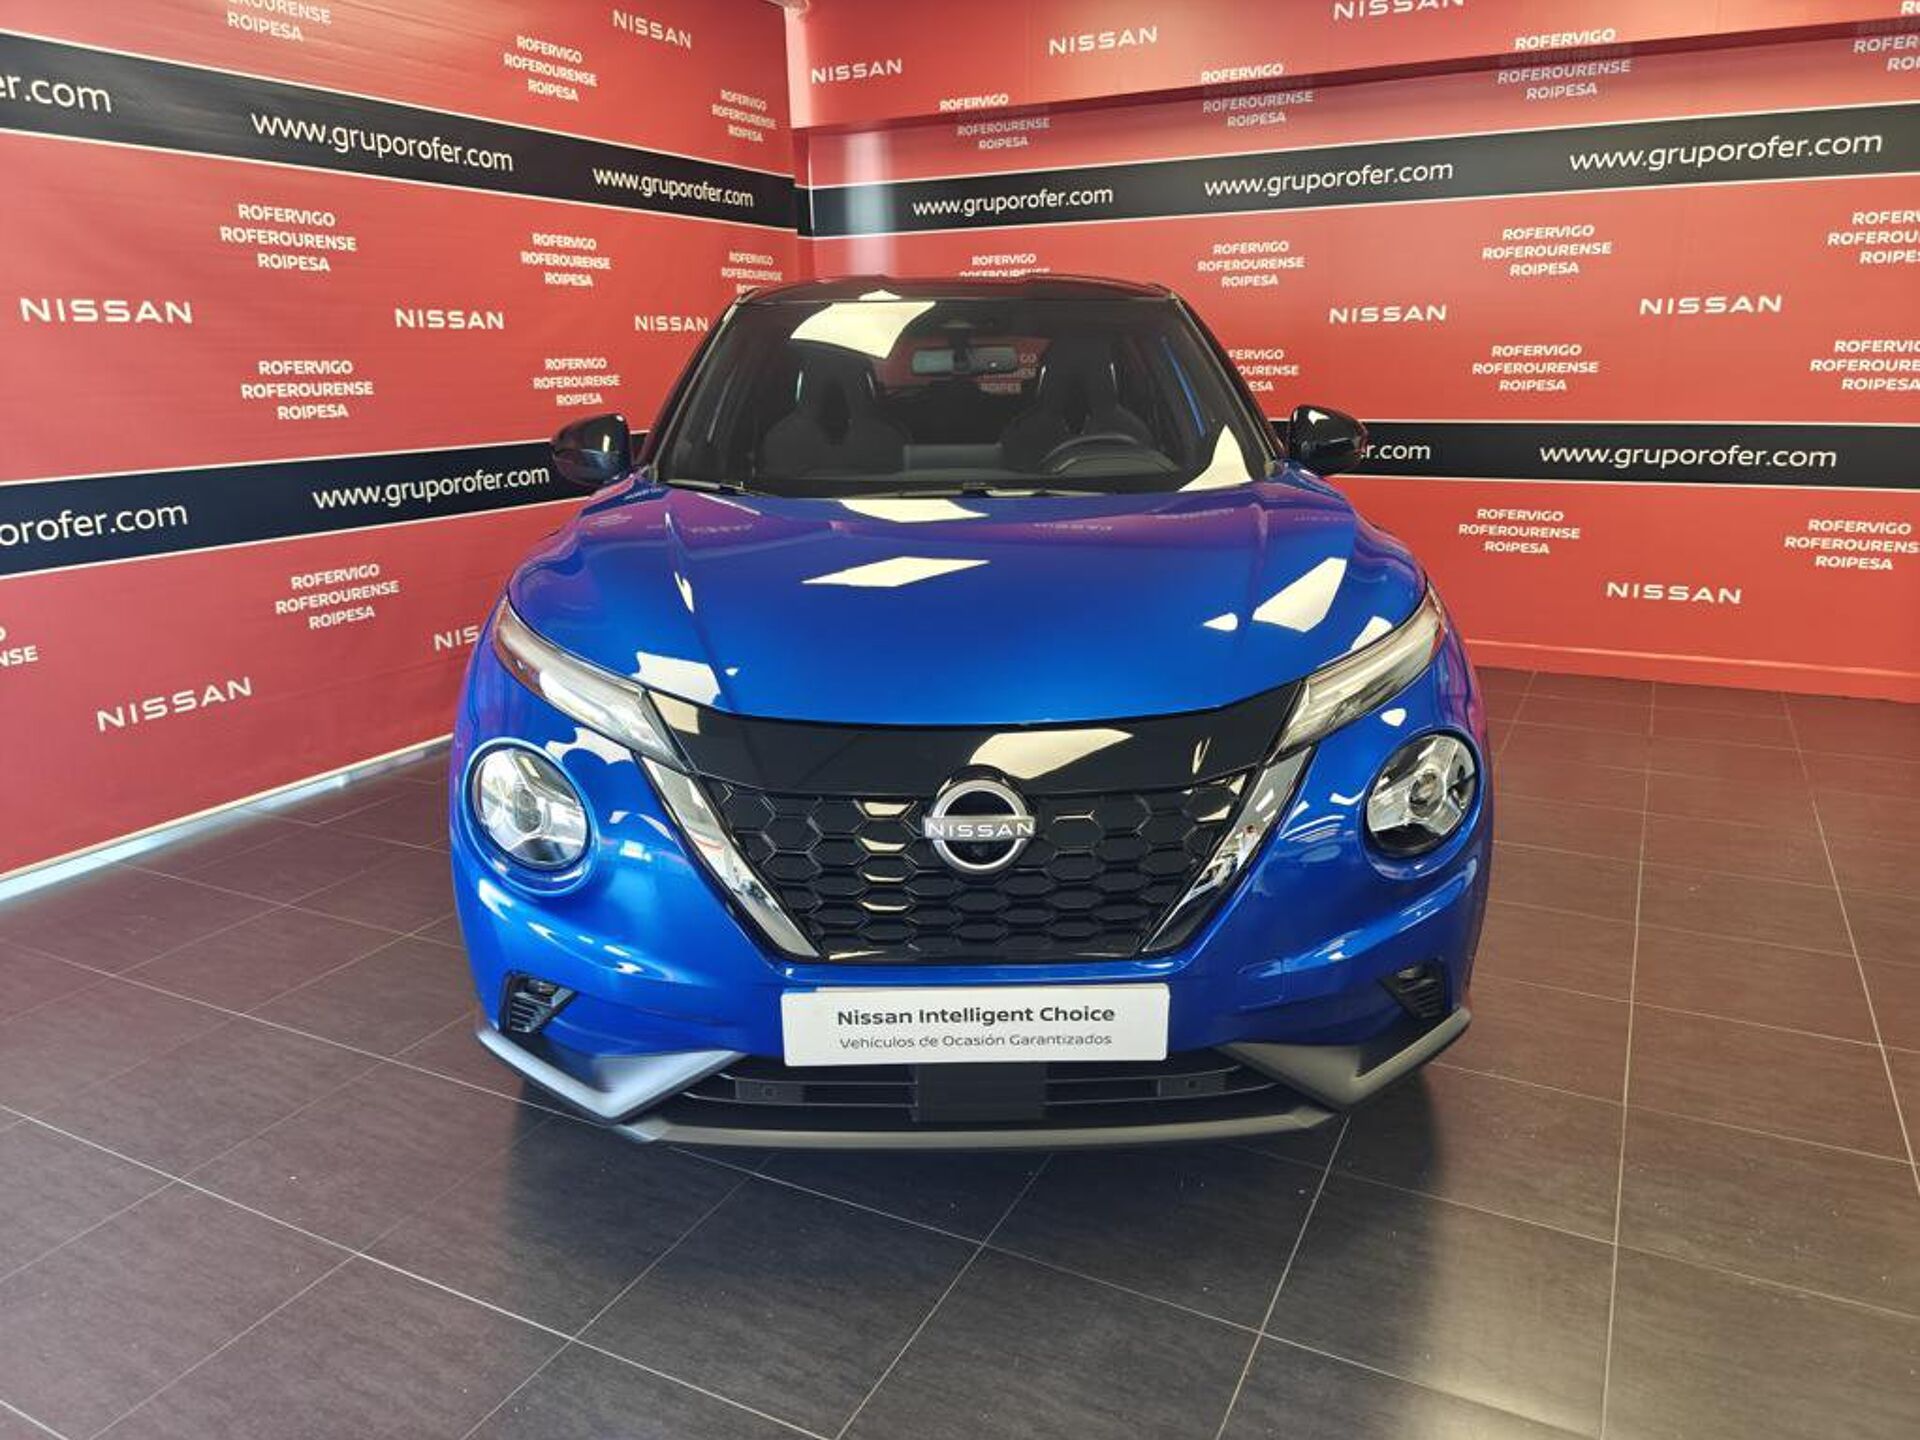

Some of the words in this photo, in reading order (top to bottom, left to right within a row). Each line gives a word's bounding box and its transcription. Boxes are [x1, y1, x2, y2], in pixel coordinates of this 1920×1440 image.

[228, 10, 304, 41] ROIPESA
[613, 10, 691, 48] NISSAN
[1050, 26, 1157, 54] NISSAN
[1514, 28, 1616, 50] ROFERVIGO
[517, 36, 582, 63] ROFERVIGO
[504, 53, 596, 86] ROFEROURENSE
[811, 58, 902, 83] NISSAN
[1201, 63, 1284, 85] ROFERVIGO
[1497, 60, 1631, 84] ROFEROURENSE
[528, 79, 578, 101] ROIPESA
[1527, 83, 1597, 99] ROIPESA
[940, 93, 1009, 111] ROFERVIGO
[1203, 91, 1313, 113] ROFEROURENSE
[957, 118, 1050, 136] ROFEROURENSE
[1228, 112, 1286, 126] ROIPESA
[252, 114, 512, 171] www.gruporofer.com
[979, 137, 1028, 149] ROIPESA
[1570, 135, 1881, 171] www.gruporofer.com
[593, 169, 753, 206] www.gruporofer.com
[1205, 164, 1452, 196] www.gruporofer.com
[913, 189, 1113, 216] www.gruporofer.com
[238, 204, 335, 226] ROFERVIGO
[220, 226, 356, 251] ROFEROURENSE
[1503, 225, 1594, 240] ROFERVIGO
[533, 233, 596, 250] ROFERVIGO
[1214, 241, 1289, 254] ROFERVIGO
[1483, 242, 1611, 258] ROFEROURENSE
[258, 253, 330, 271] ROIPESA
[521, 252, 610, 269] ROFEROURENSE
[972, 254, 1036, 265] ROFERVIGO
[1198, 257, 1304, 271] ROFEROURENSE
[1860, 250, 1920, 263] ROIPE
[1510, 262, 1579, 275] ROIPESA
[545, 272, 593, 286] ROIPESA
[1222, 275, 1278, 287] ROIPESA
[21, 298, 192, 323] NISSAN
[1640, 295, 1781, 314] NISSAN
[396, 309, 503, 329] NISSAN
[1330, 305, 1446, 322] NISSAN
[635, 316, 708, 331] NISSAN
[1492, 344, 1582, 356] ROFERVIGO
[259, 361, 352, 374] ROFERVIGO
[545, 358, 607, 370] ROFERVIGO
[1473, 362, 1598, 374] ROFEROURENSE
[241, 382, 373, 398] ROFEROURENSE
[534, 375, 619, 388] ROFEROURENSE
[1500, 380, 1566, 391] ROIPESA
[556, 393, 602, 405] ROIPESA
[278, 404, 348, 419] ROIPESA
[1540, 445, 1836, 468] www.gruporofer.com
[313, 468, 549, 508] www.gruporofer.com
[1478, 509, 1564, 521] ROFERVIGO
[1459, 524, 1580, 539] ROFEROURENSE
[1808, 520, 1911, 534] ROFERVIGO
[1485, 541, 1549, 553] ROIPESA
[1816, 556, 1892, 569] ROIPESA
[291, 564, 379, 589] ROFERVIGO
[276, 581, 398, 614] ROFEROURENSE
[1608, 583, 1741, 603] NISSAN
[309, 606, 374, 629] ROIPESA
[97, 677, 251, 731] NISSAN
[927, 821, 1034, 837] NISSAN
[838, 1009, 913, 1025] Nissan
[919, 1007, 1033, 1026] Intelligent
[1040, 1005, 1115, 1021] Choice
[920, 1036, 938, 1047] de
[942, 1034, 1004, 1046] Ocasión
[1009, 1034, 1112, 1045] Garantizados
